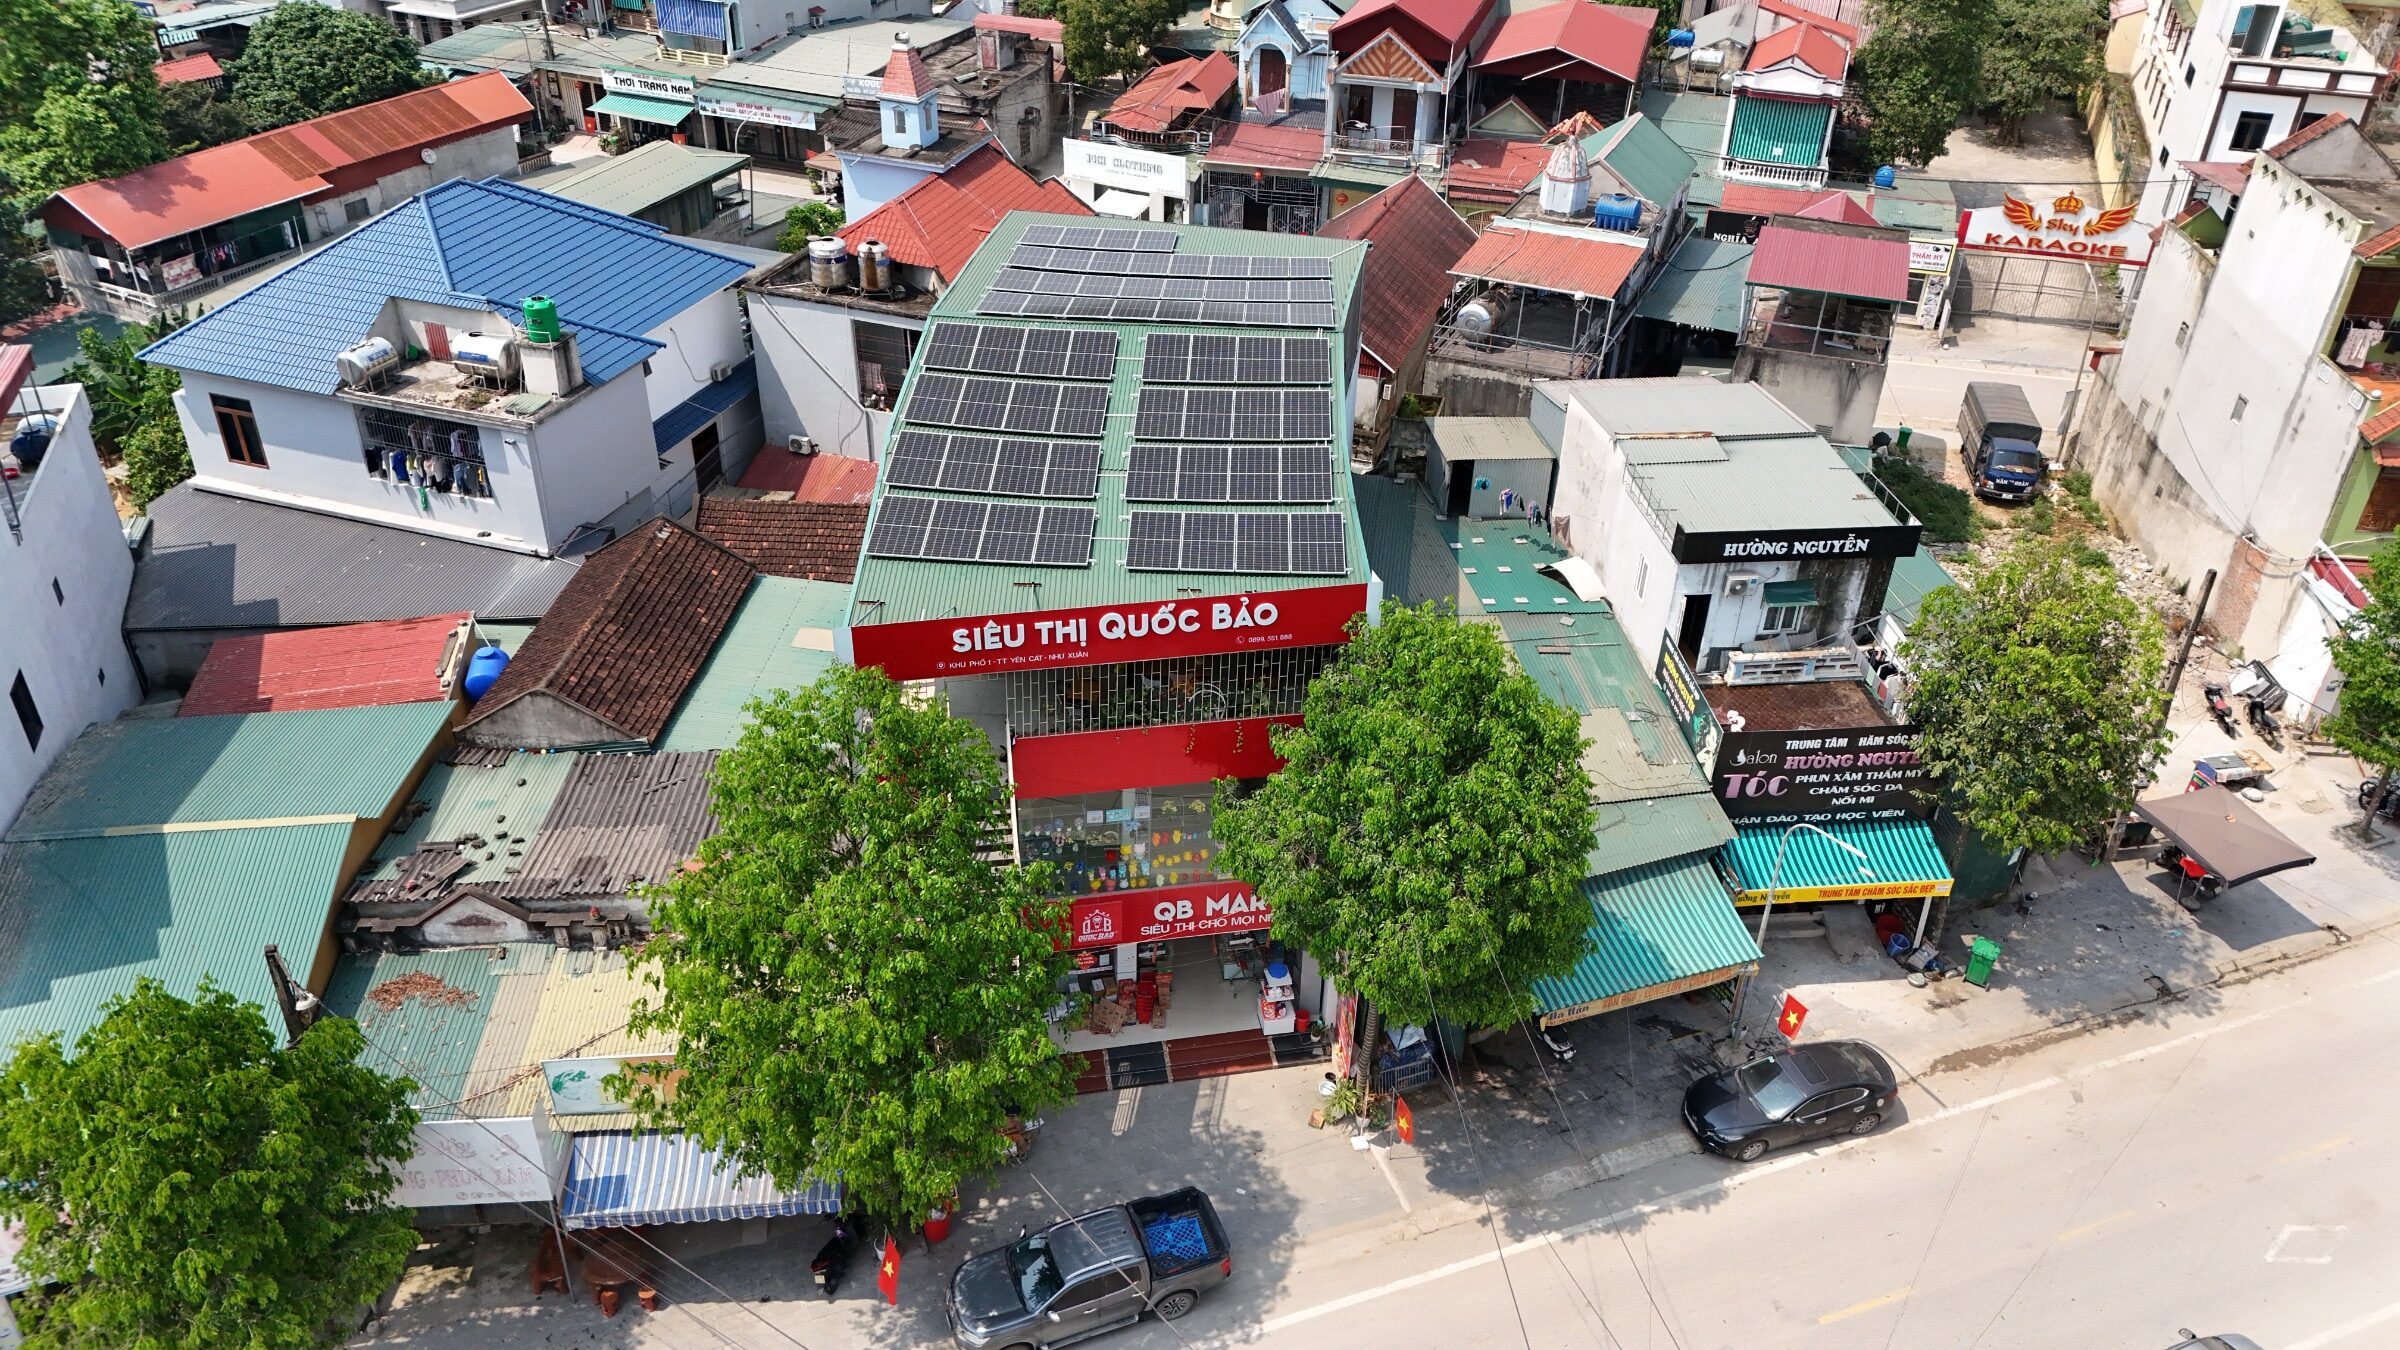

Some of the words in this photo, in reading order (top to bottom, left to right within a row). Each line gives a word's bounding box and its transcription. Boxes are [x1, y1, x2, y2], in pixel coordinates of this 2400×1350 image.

[638, 80, 668, 92] TRANG
[2046, 219, 2080, 235] Sky
[1984, 233, 2128, 257] KARAOKE
[1723, 538, 1788, 556] HƯỜNG
[1792, 534, 1870, 554] NGUYỄN
[952, 619, 1025, 653] SIÊU
[1034, 618, 1086, 647] THỊ
[1099, 603, 1201, 640] QUỐC
[1212, 597, 1279, 630] BẢO
[949, 661, 966, 669] KHU
[969, 658, 986, 667] PHỐ
[1009, 655, 1026, 663] YÊN
[1067, 650, 1089, 659] XUÂN
[1786, 739, 1822, 750] TRUNG
[1825, 737, 1848, 748] TÂM
[1784, 752, 1854, 769] HƯỜNG
[1795, 774, 1831, 783] PHUN
[1833, 771, 1862, 782] XĂM
[1866, 766, 1903, 780] THẨM
[1723, 771, 1789, 799] TÓC
[1809, 785, 1850, 795] CHĂM
[1853, 782, 1882, 793] SÓC
[1885, 783, 1904, 791] DA
[1803, 813, 1832, 823] TẠO
[1835, 811, 1867, 821] HỌC
[1818, 889, 1843, 898] TRUNG
[1844, 888, 1861, 897] TÂM
[1861, 885, 1885, 896] CHĂM
[1154, 900, 1194, 922] QB
[1141, 924, 1171, 936] SIÊU
[1174, 921, 1195, 933] THỊ
[1198, 918, 1228, 930] CHO
[1231, 915, 1255, 927] MỌI
